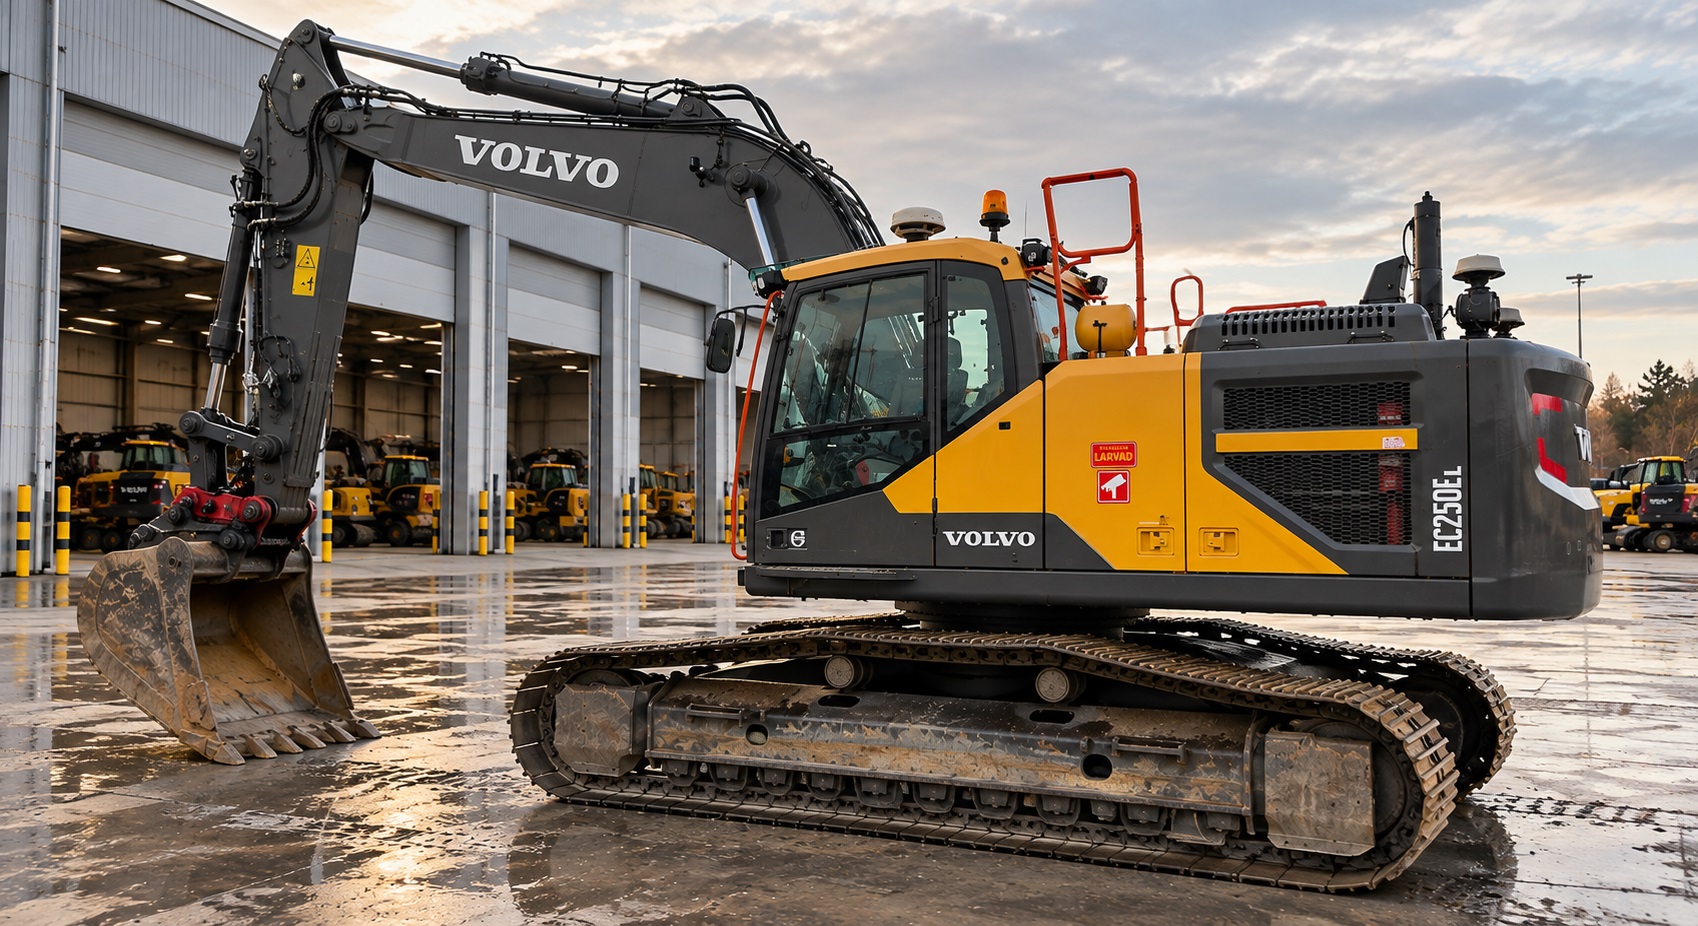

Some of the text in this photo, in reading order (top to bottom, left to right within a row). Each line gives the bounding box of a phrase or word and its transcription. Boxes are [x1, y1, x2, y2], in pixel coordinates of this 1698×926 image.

[455, 134, 620, 189] VOLVO
[1094, 452, 1133, 462] LARVAD
[942, 531, 1036, 547] VOLVO
